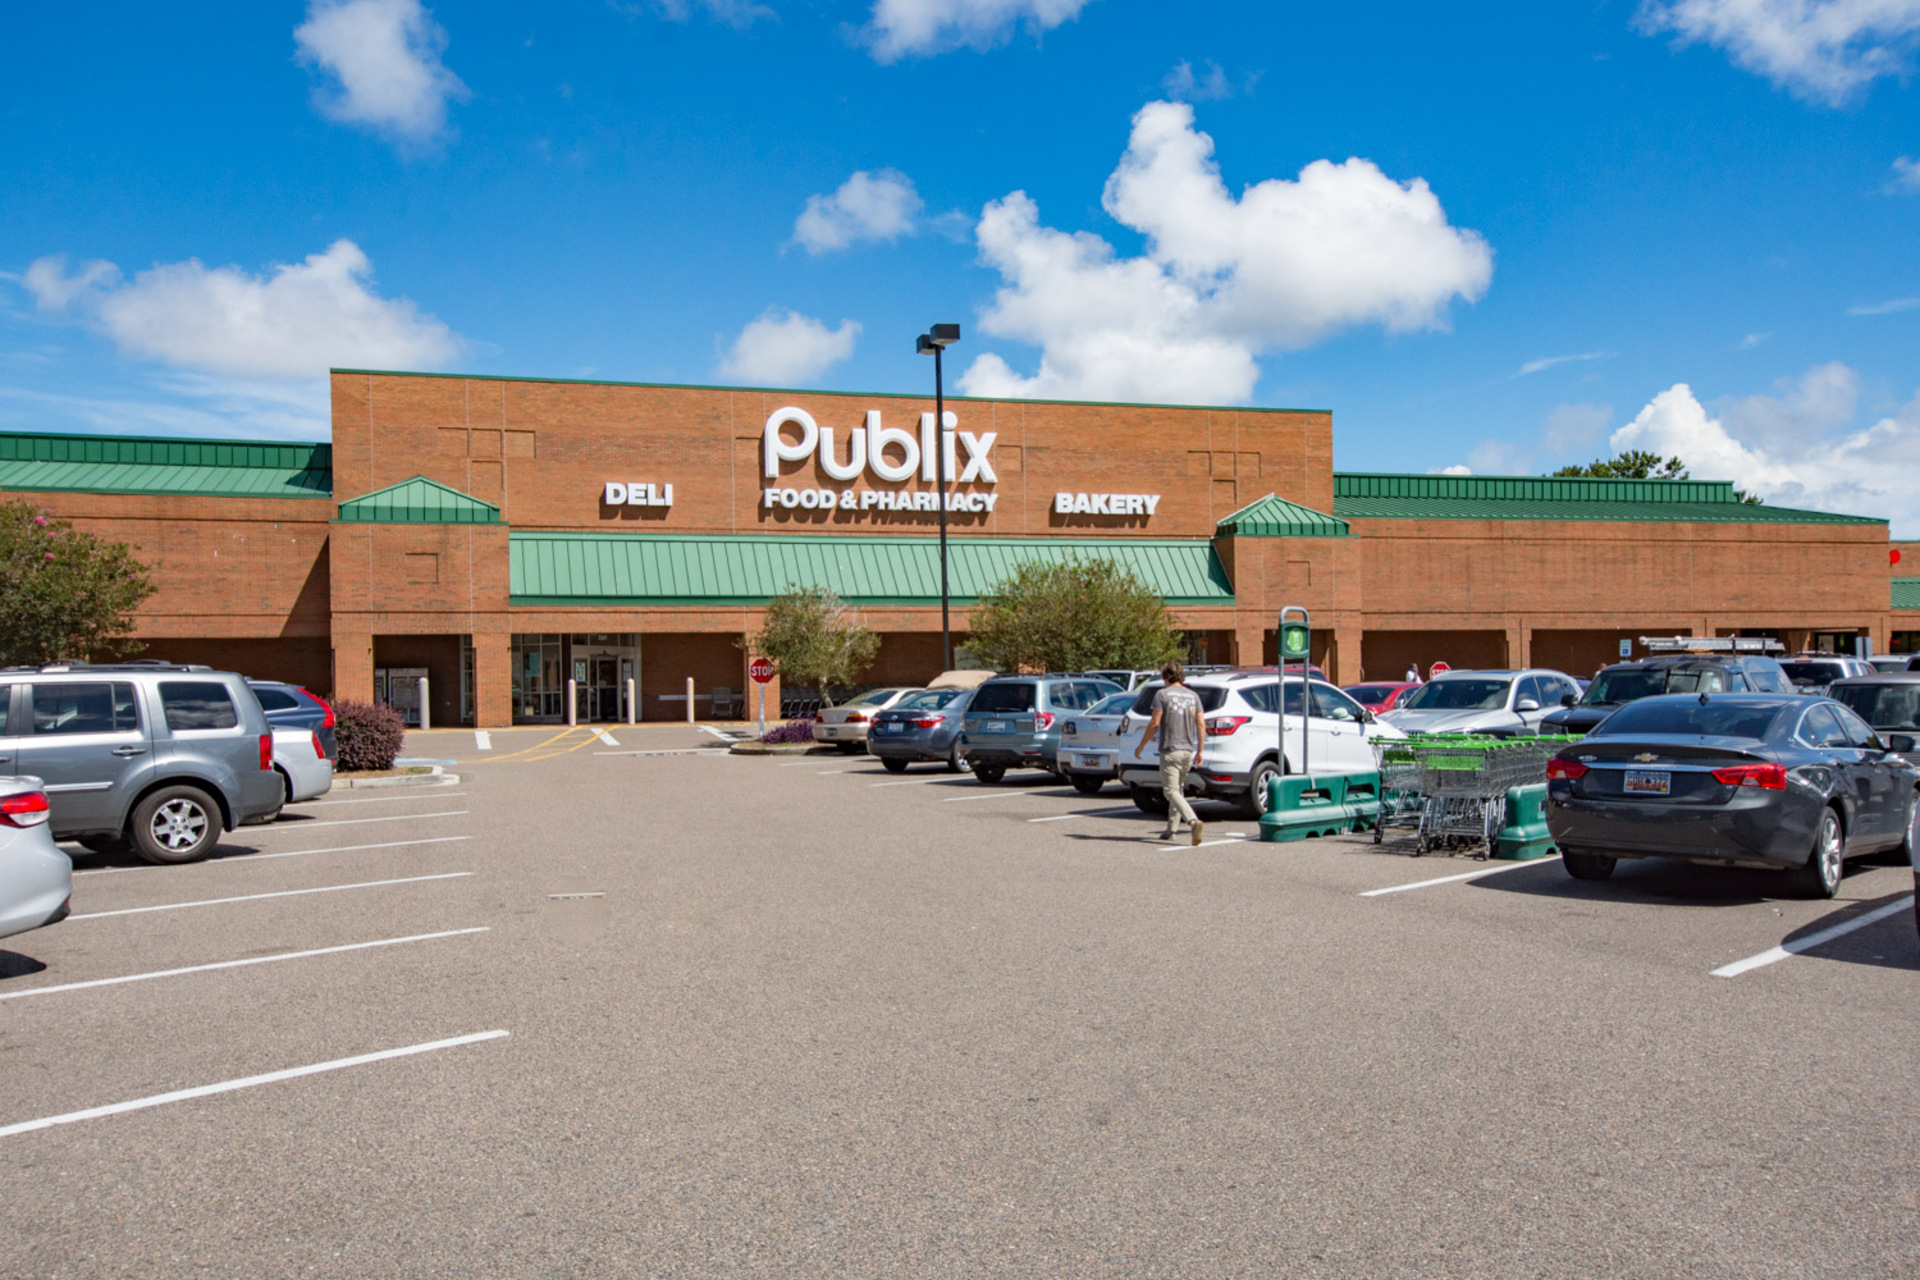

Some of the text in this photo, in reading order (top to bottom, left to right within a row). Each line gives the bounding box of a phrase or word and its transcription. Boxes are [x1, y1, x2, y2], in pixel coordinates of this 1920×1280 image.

[765, 406, 998, 483] Publix
[605, 482, 673, 506] DELI
[765, 488, 998, 512] FOOD & PHARMACY
[1055, 492, 1161, 515] BAKERY
[751, 665, 774, 676] STOP
